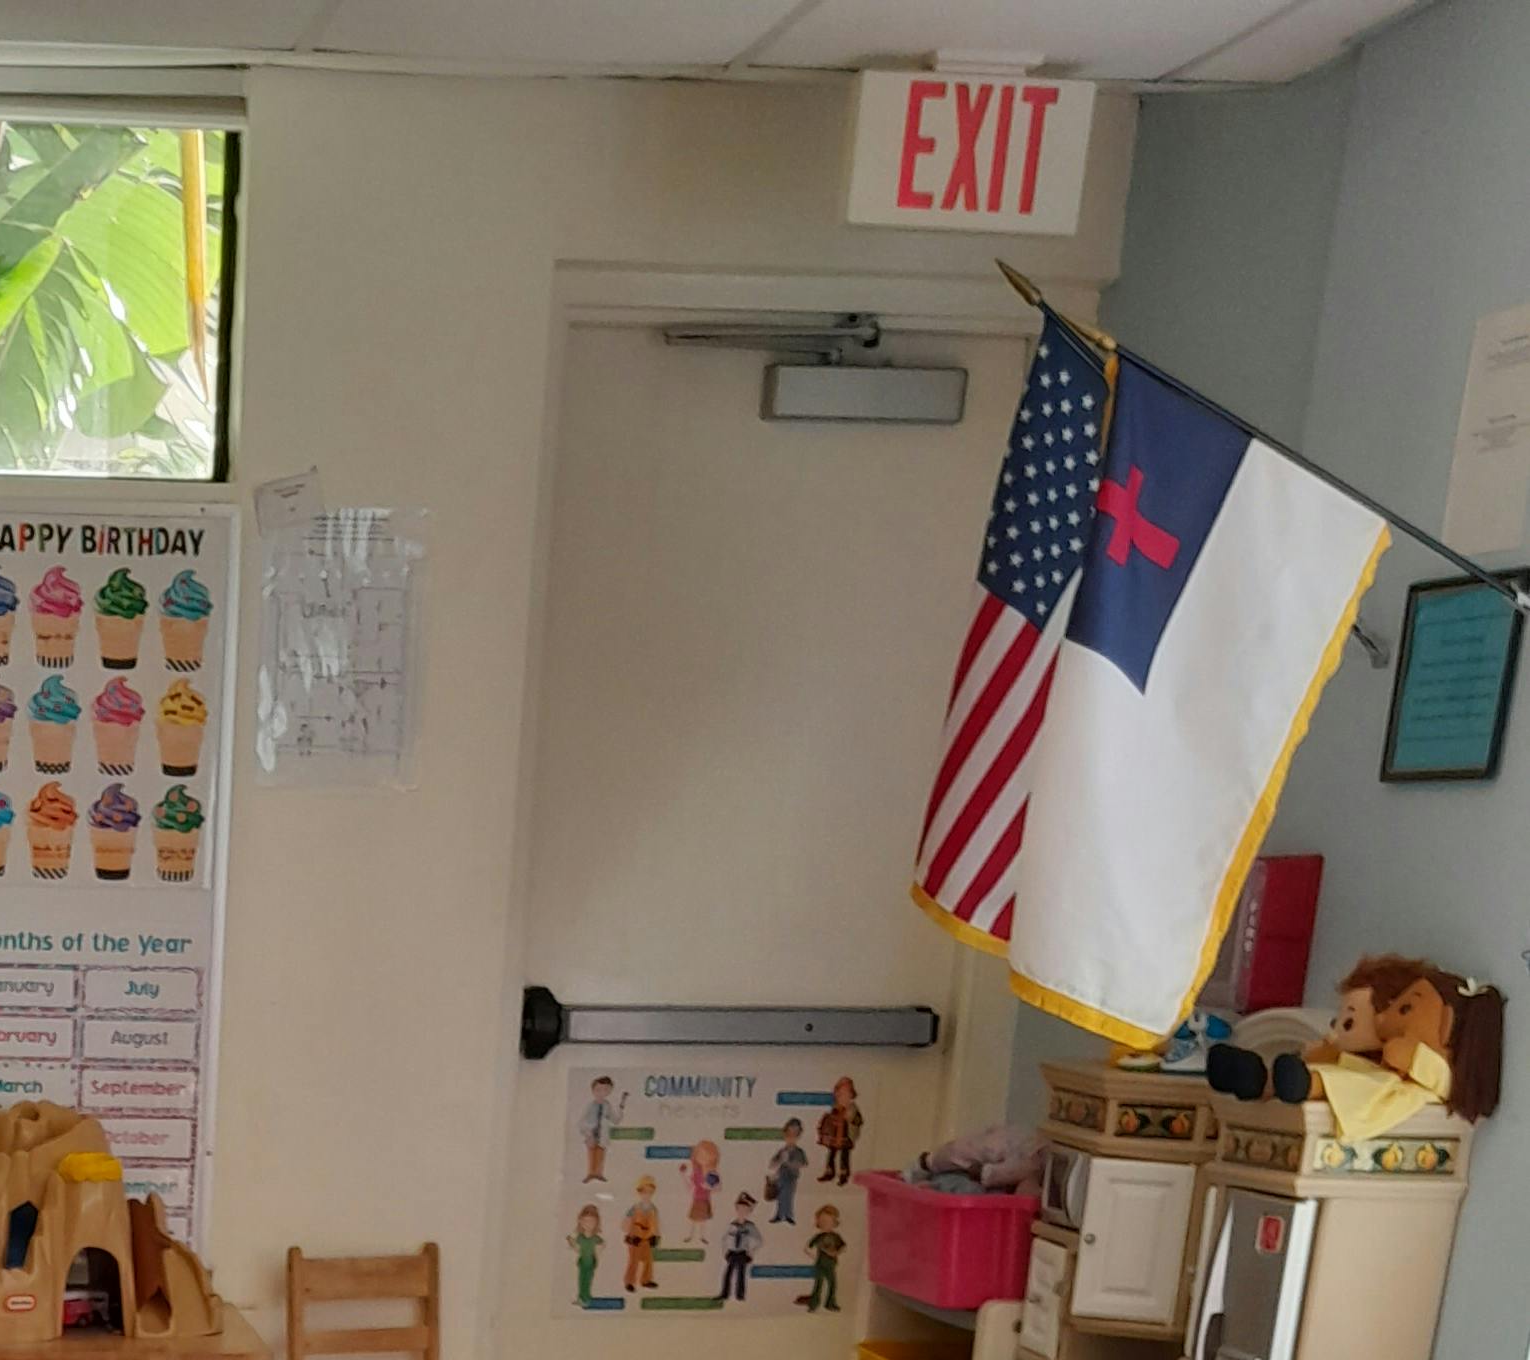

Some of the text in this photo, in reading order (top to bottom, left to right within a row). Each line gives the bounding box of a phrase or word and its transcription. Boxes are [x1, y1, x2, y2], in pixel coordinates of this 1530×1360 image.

[897, 80, 1060, 215] EXIT
[62, 931, 84, 951] of
[90, 931, 130, 952] the
[139, 934, 192, 956] Year
[124, 980, 160, 999] July
[111, 1029, 168, 1048] August
[90, 1079, 187, 1097] September
[643, 1075, 757, 1099] COMMUNITY
